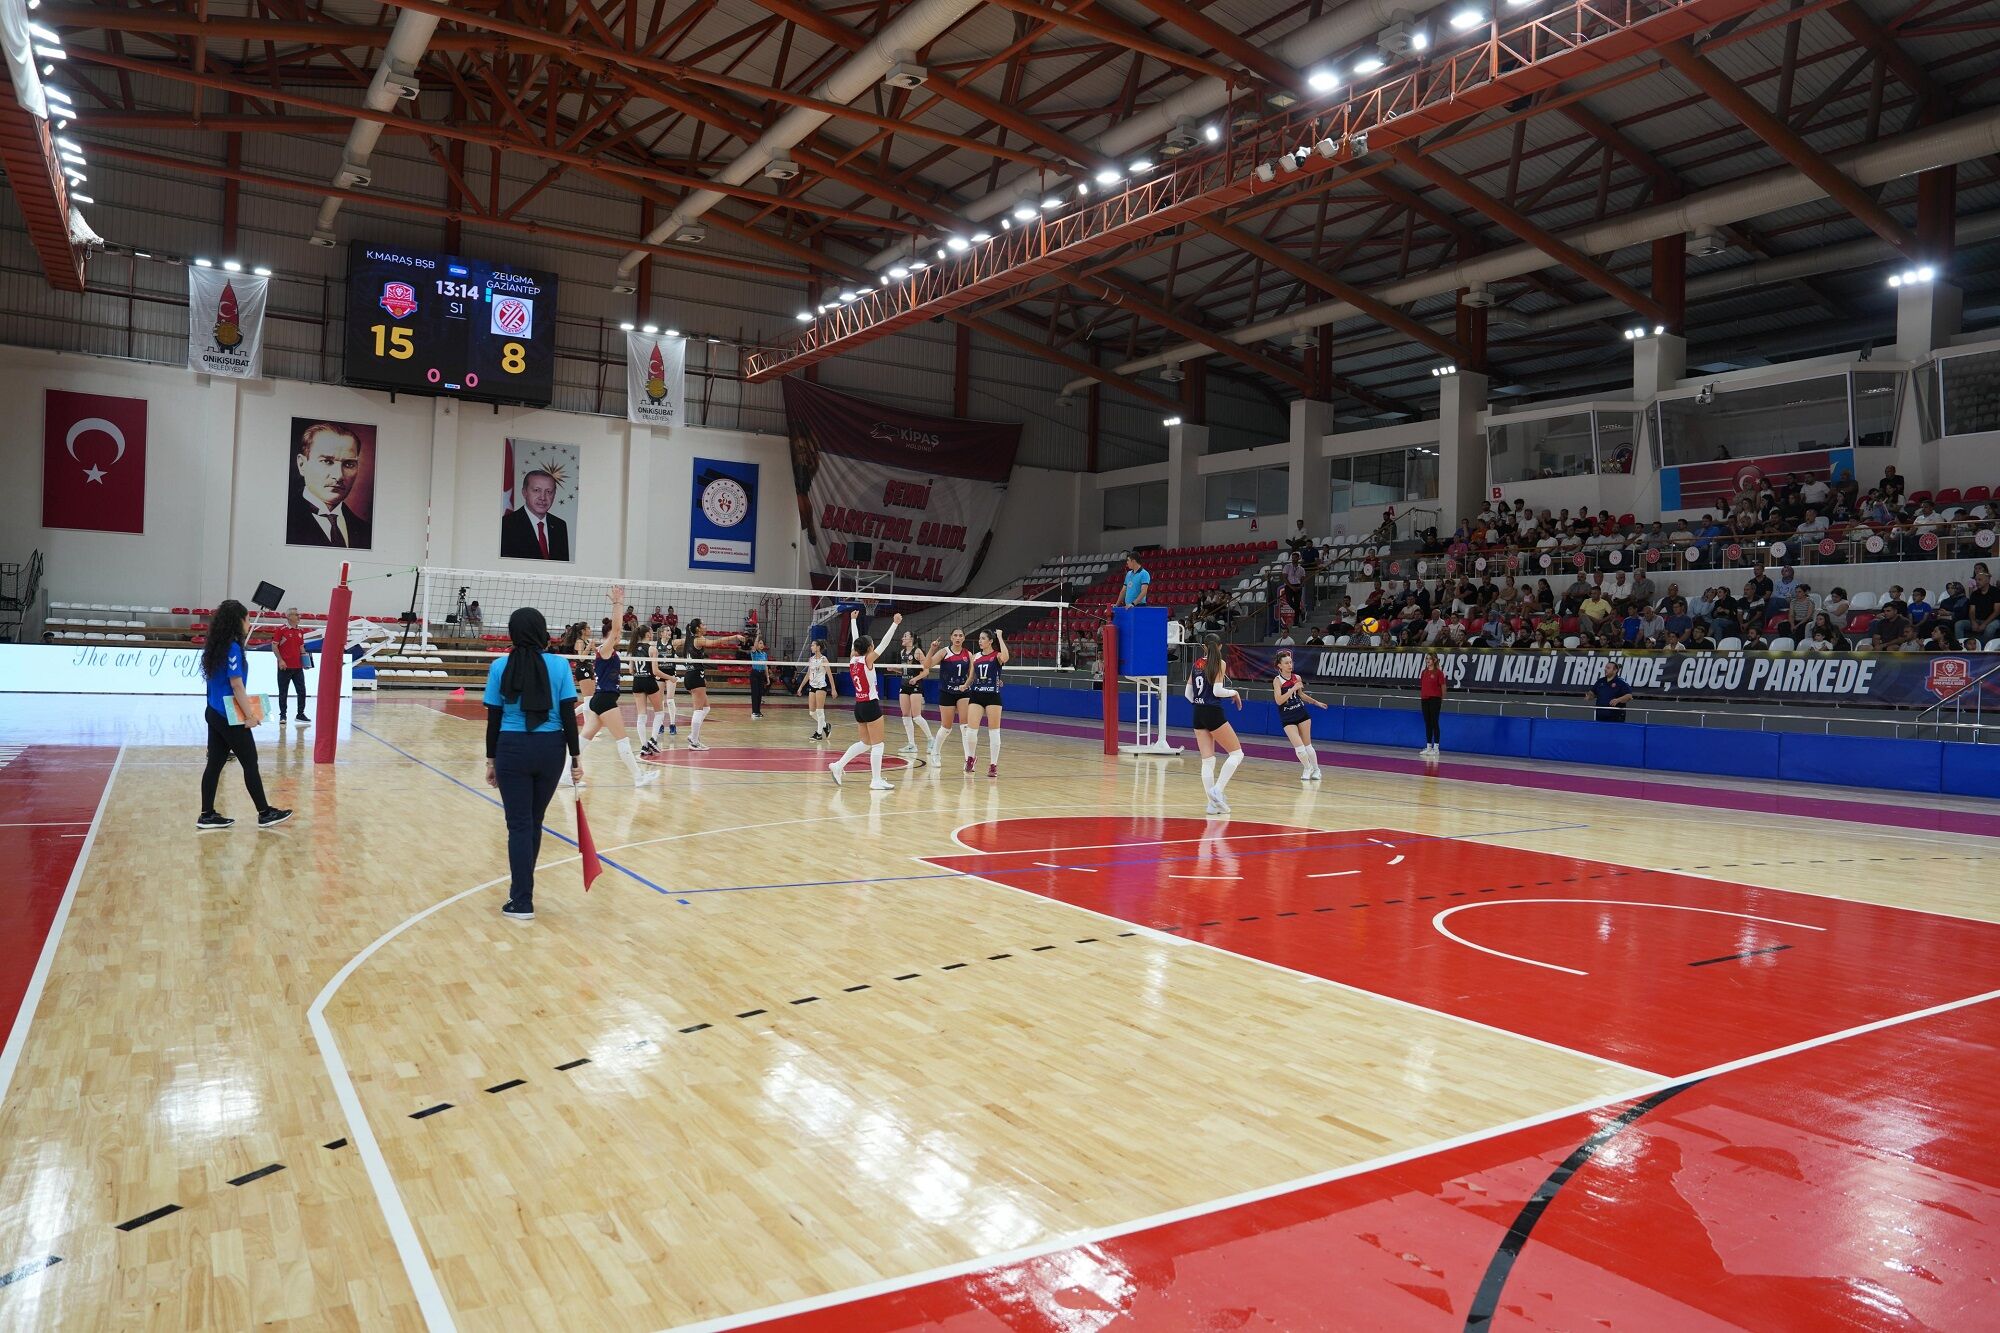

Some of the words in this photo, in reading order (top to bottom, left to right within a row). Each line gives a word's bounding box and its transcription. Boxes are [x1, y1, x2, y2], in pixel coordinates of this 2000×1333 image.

[366, 250, 413, 267] K.MARAŞ
[415, 258, 435, 269] BŞB
[486, 279, 541, 295] GAZİANTEP
[493, 271, 534, 286] ZEUGMA
[436, 280, 479, 300] 13:14
[450, 302, 463, 314] S1
[370, 324, 414, 360] 15
[501, 342, 526, 374] 8
[427, 368, 441, 383] 0
[465, 372, 479, 388] 0
[900, 427, 940, 448] KİPAŞ
[1492, 487, 1502, 499] B
[820, 503, 914, 544] BASKETBOL
[115, 650, 142, 668] art
[149, 648, 170, 677] of
[977, 663, 989, 677] 17
[1498, 650, 1558, 686] KALBİ
[1677, 651, 1746, 691] GÜCÜ
[1748, 658, 1877, 695] PARKEDE
[853, 675, 863, 692] 3
[1195, 676, 1204, 696] 9
